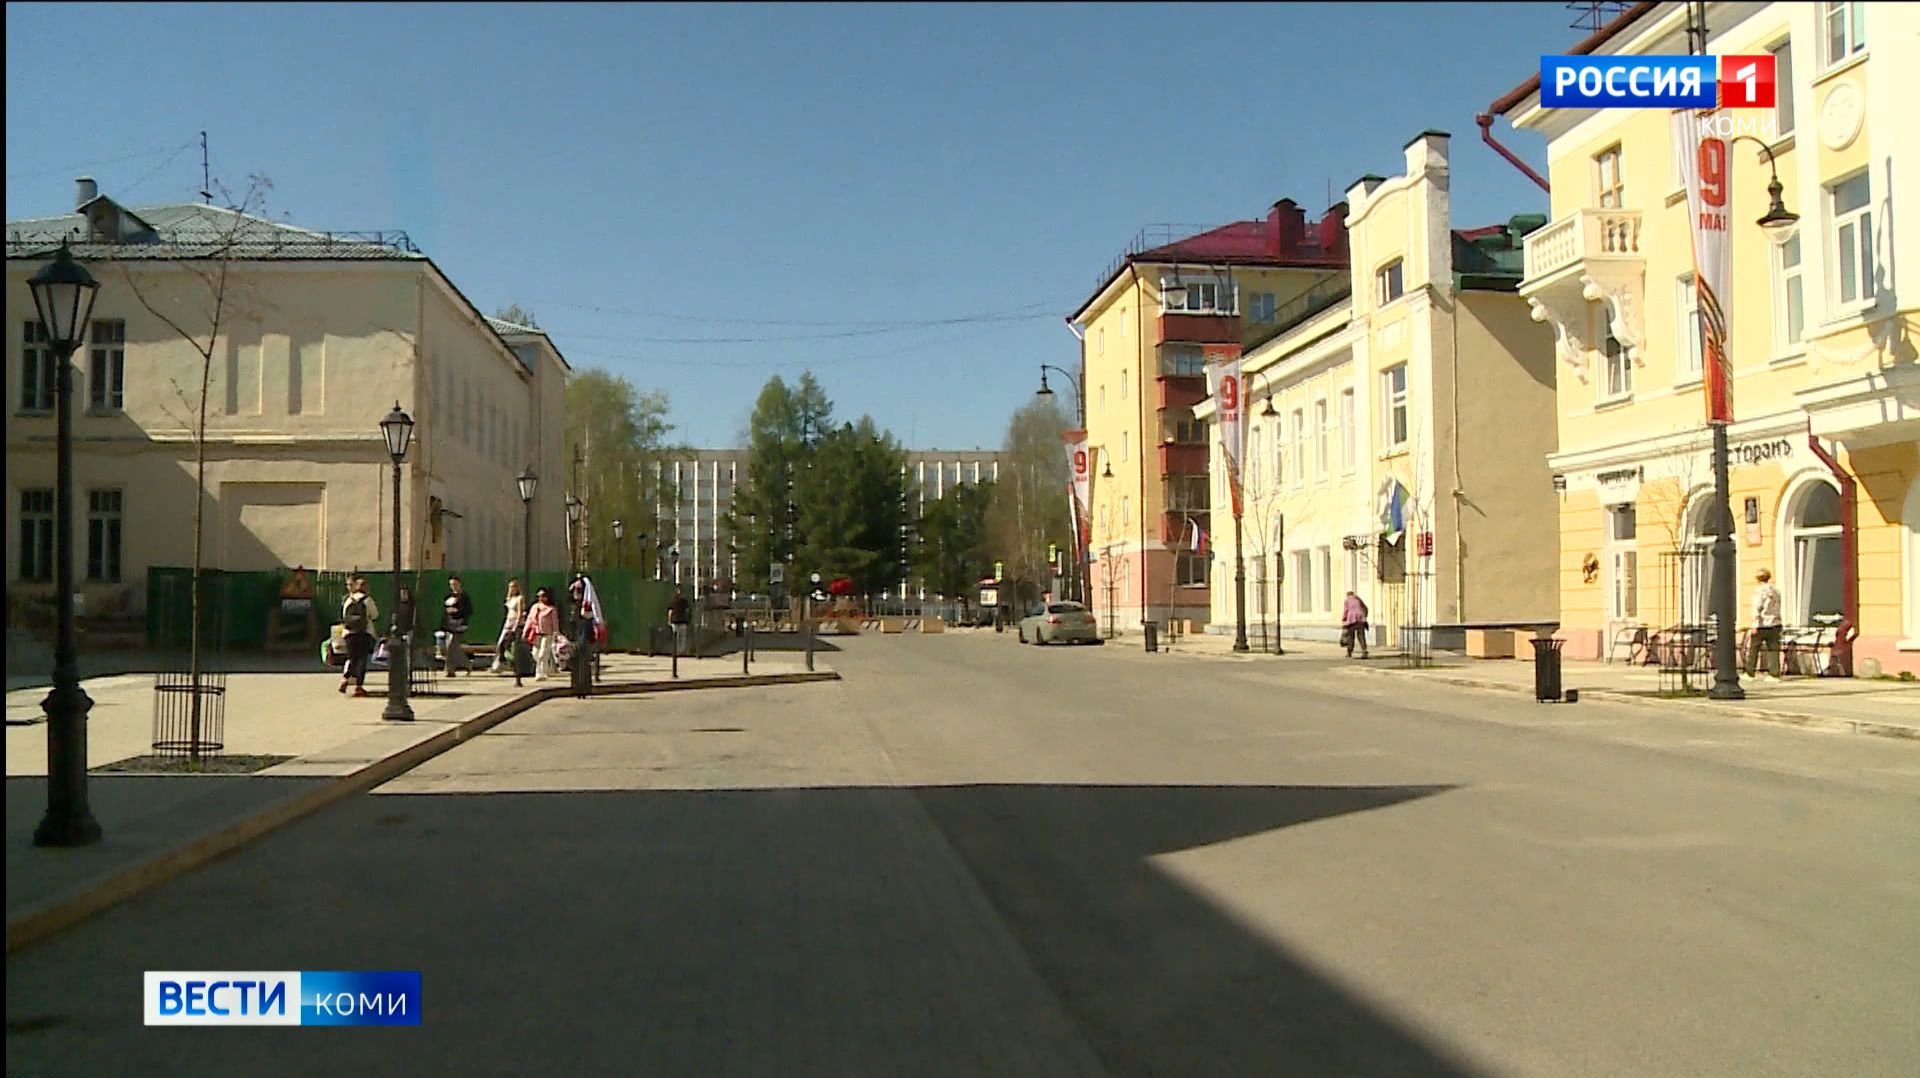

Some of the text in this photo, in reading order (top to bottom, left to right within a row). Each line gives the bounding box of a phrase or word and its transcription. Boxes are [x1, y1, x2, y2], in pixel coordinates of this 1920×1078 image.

[1698, 138, 1725, 207] 9
[1221, 375, 1237, 409] 9
[1074, 451, 1086, 474] 9
